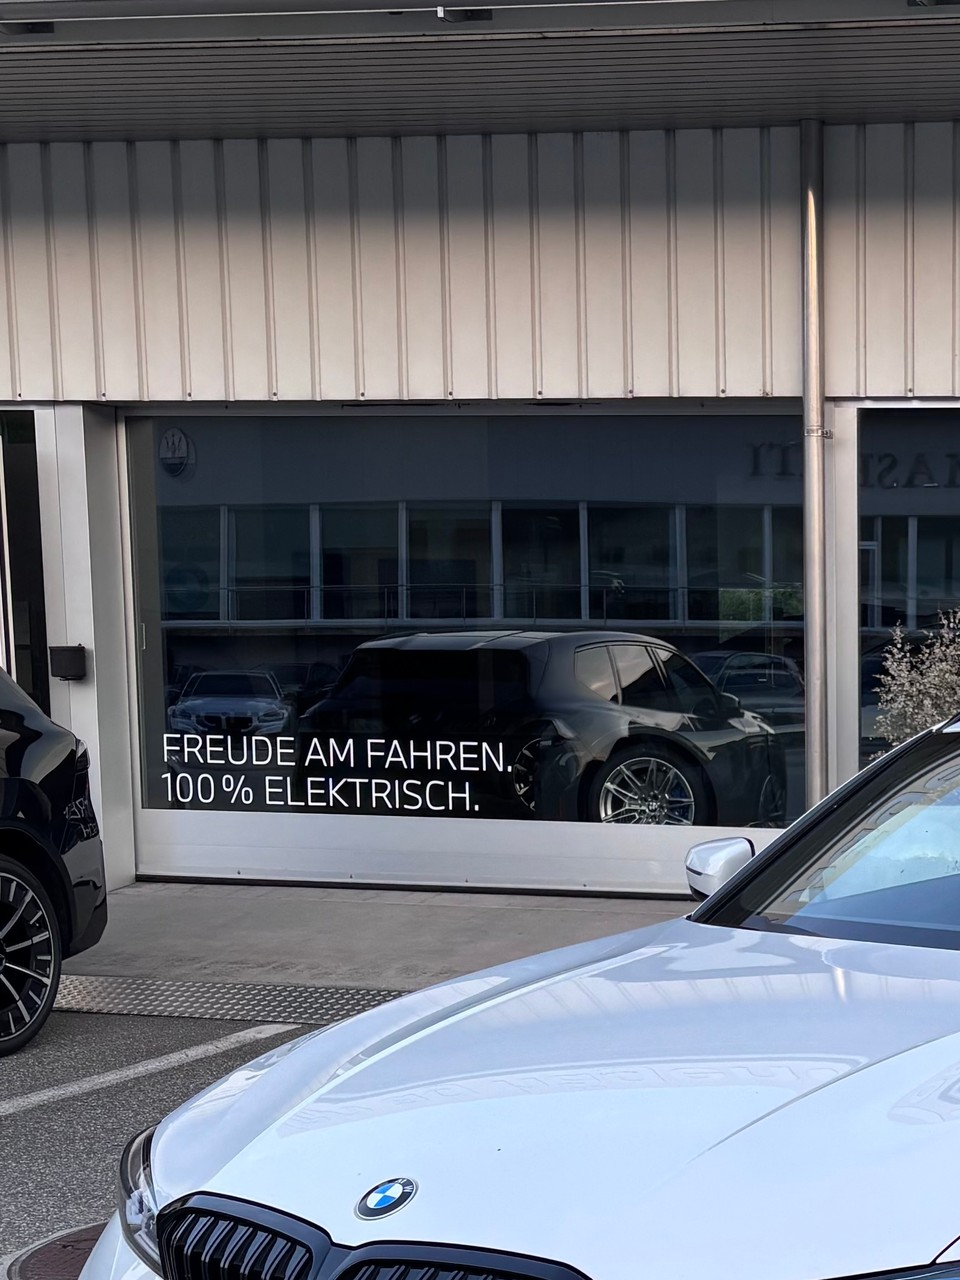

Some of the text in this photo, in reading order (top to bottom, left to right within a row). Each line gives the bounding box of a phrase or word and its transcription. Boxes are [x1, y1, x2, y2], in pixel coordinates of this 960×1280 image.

[162, 733, 512, 773] FREUDE AM FAHREN.
[265, 776, 480, 812] ELEKTRISCH.
